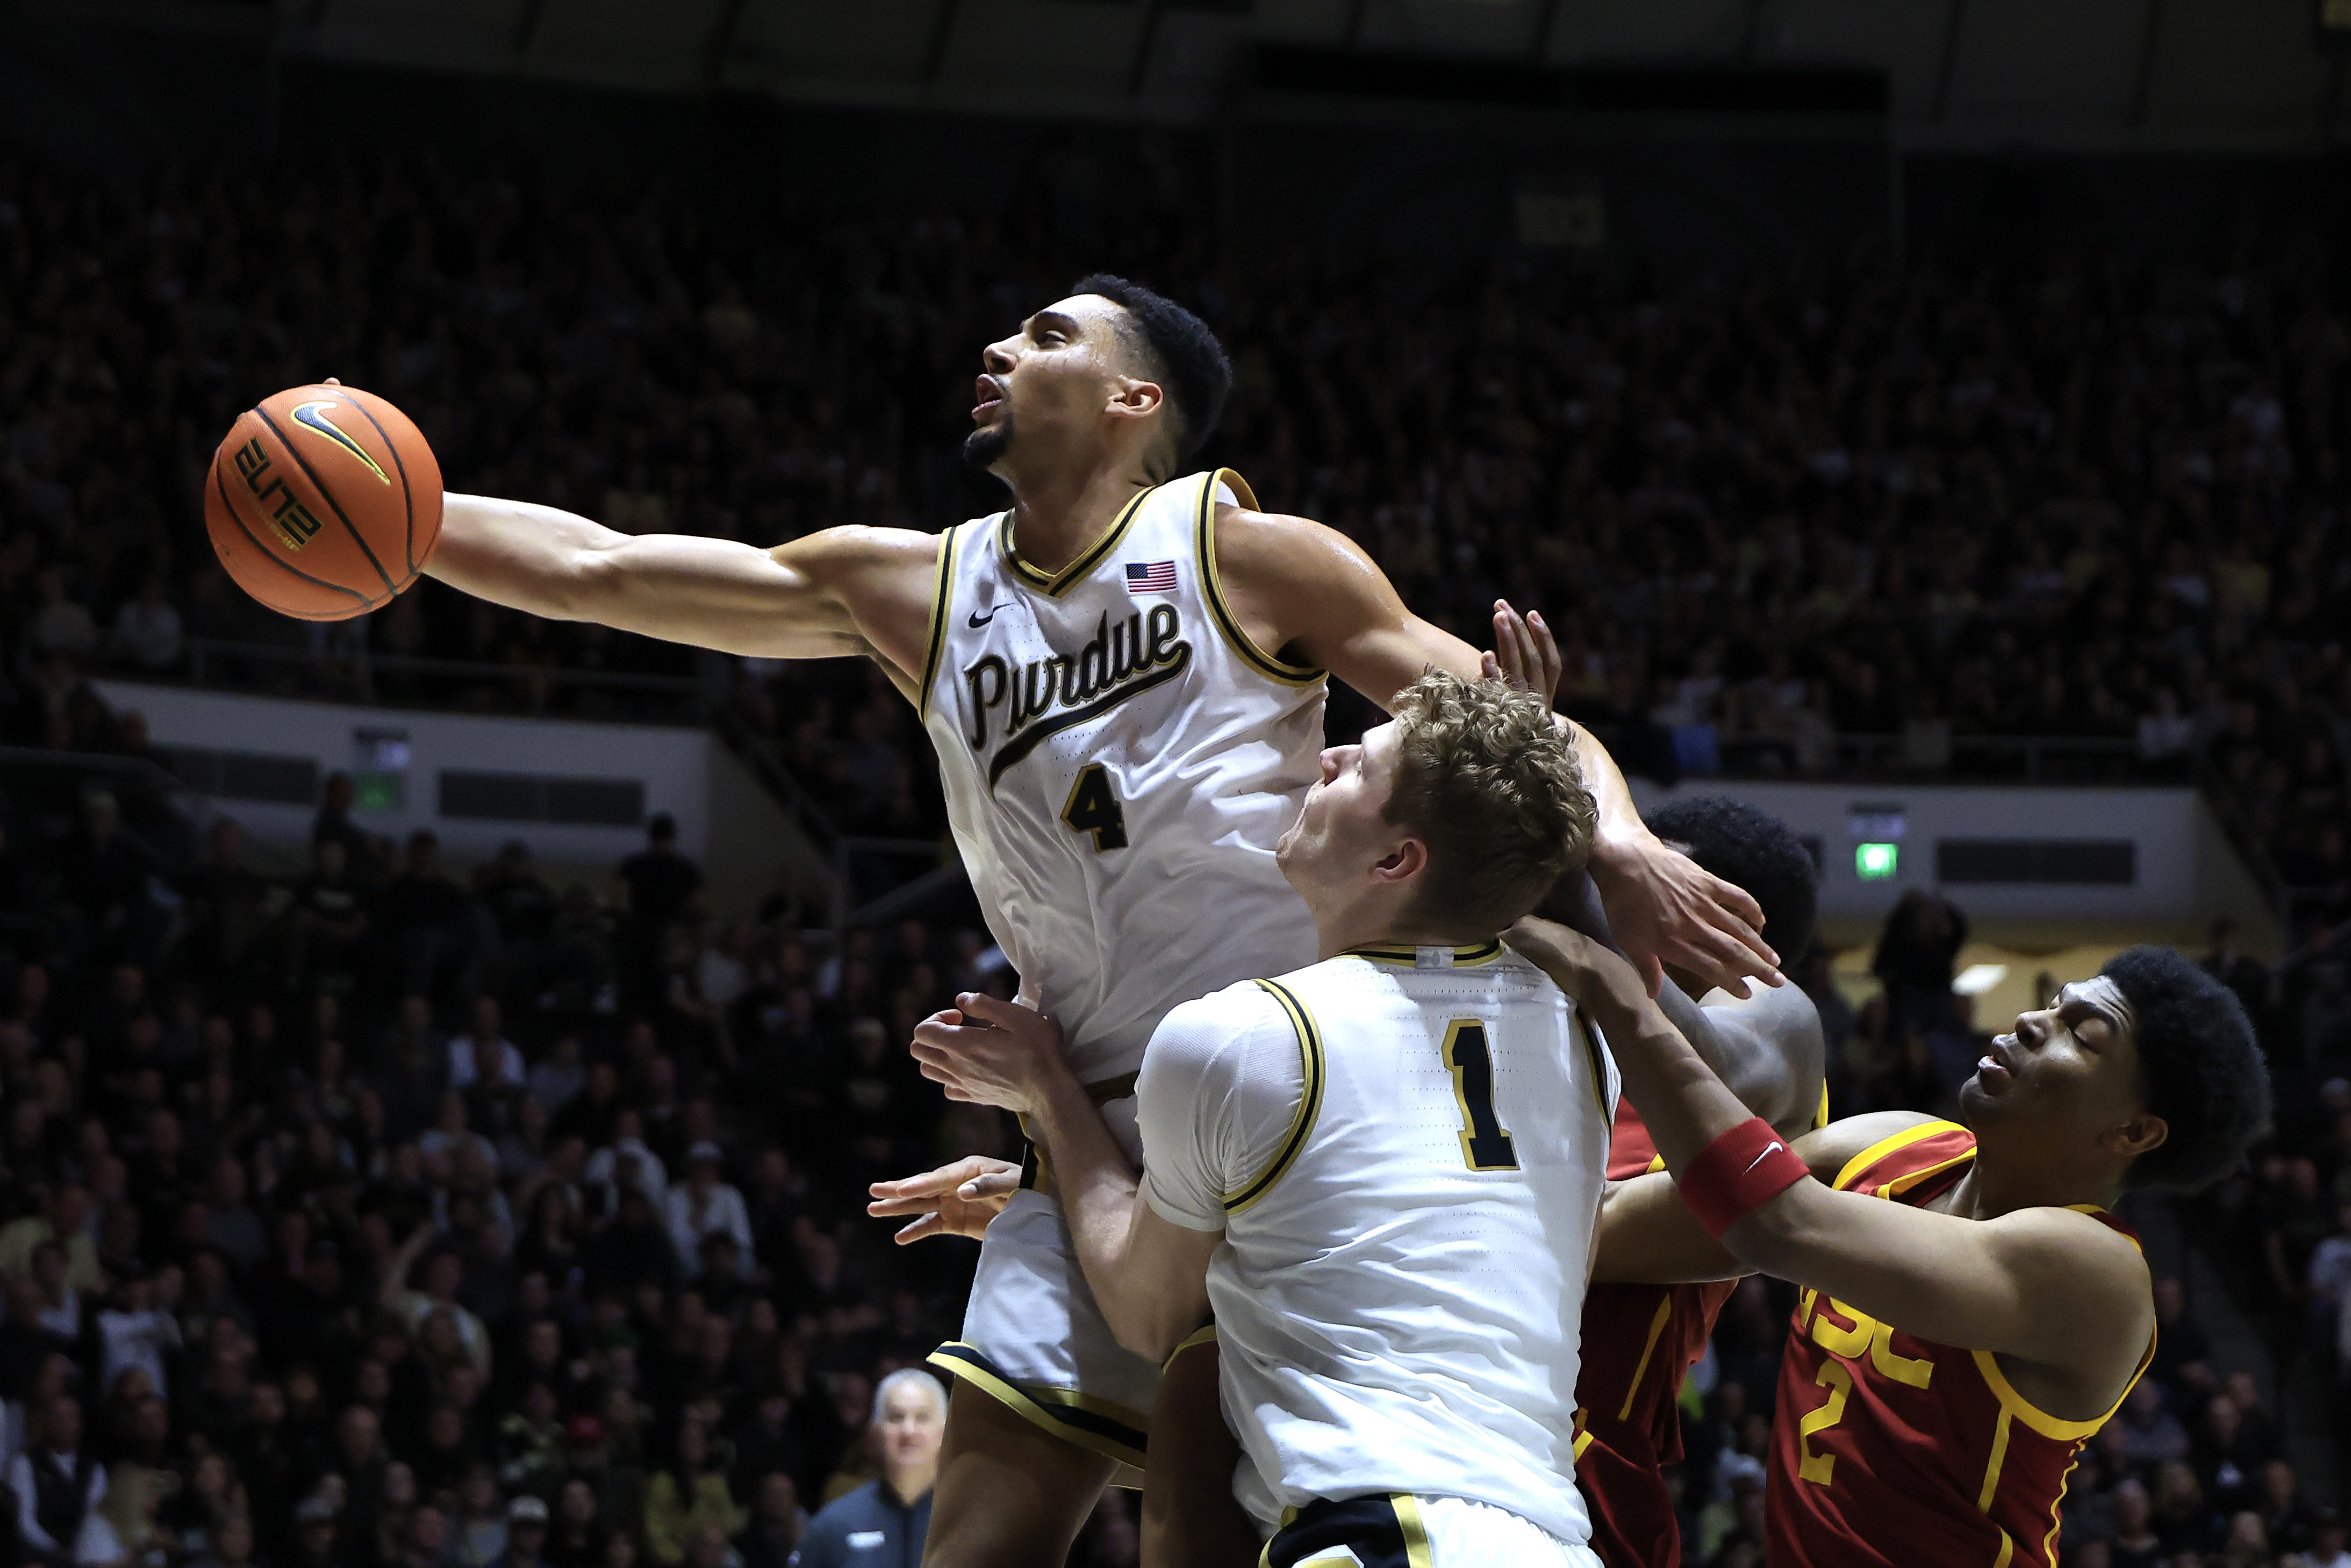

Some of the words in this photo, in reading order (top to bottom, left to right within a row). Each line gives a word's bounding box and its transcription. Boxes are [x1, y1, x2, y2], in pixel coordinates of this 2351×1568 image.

[234, 436, 324, 548] ELITE
[966, 604, 1180, 751] Purdue
[1060, 763, 1128, 853] 4
[1441, 1019, 1520, 1171] 1
[1798, 1357, 1853, 1486] 2
